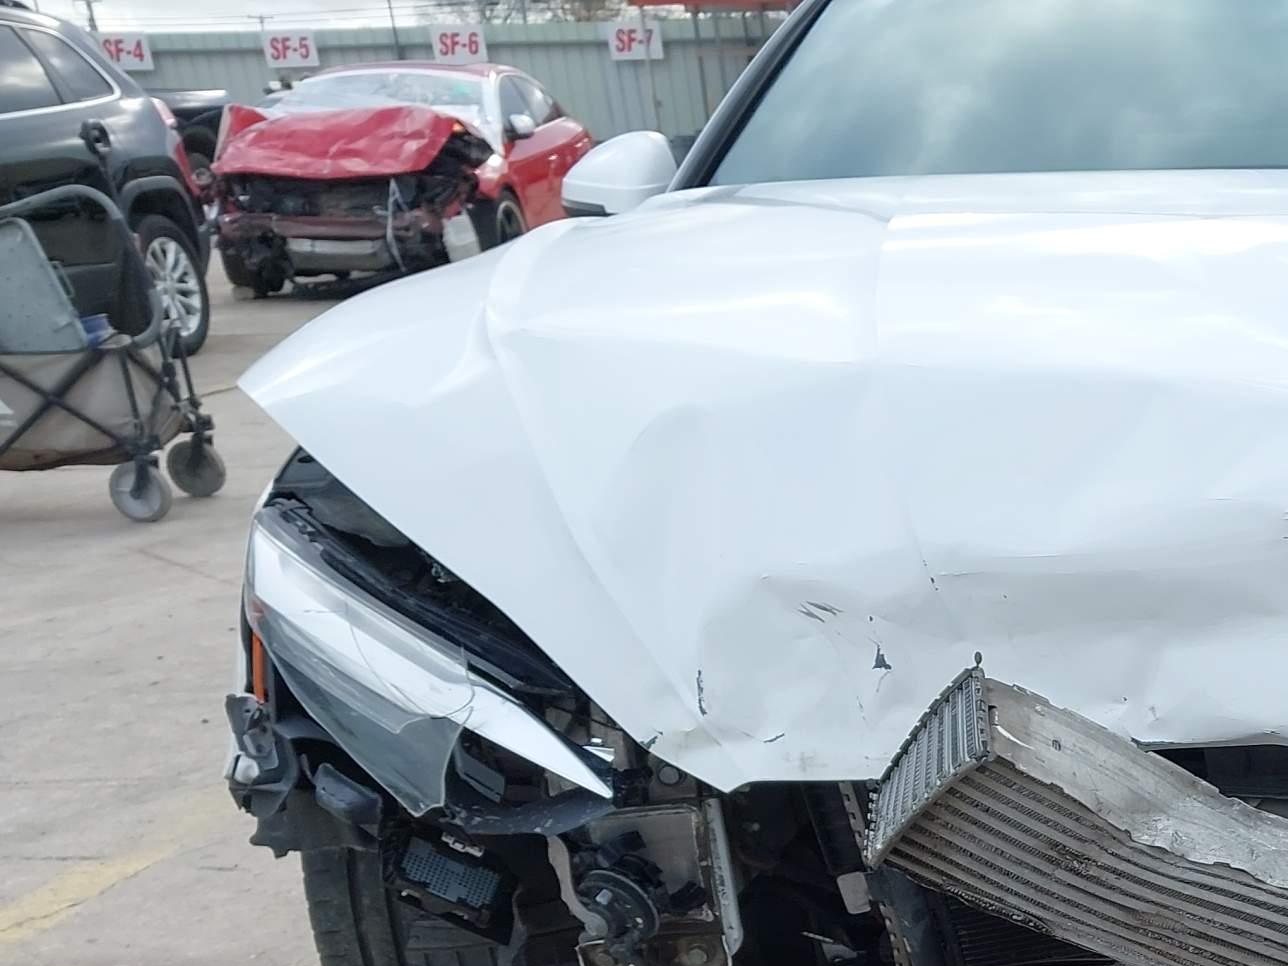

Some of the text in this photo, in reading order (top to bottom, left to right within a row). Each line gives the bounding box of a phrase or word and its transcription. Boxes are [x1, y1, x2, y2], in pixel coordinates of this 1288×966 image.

[102, 38, 145, 63] SF-4
[270, 36, 311, 60] SF-5
[439, 32, 480, 56] SF-6
[615, 28, 654, 52] SF-7
